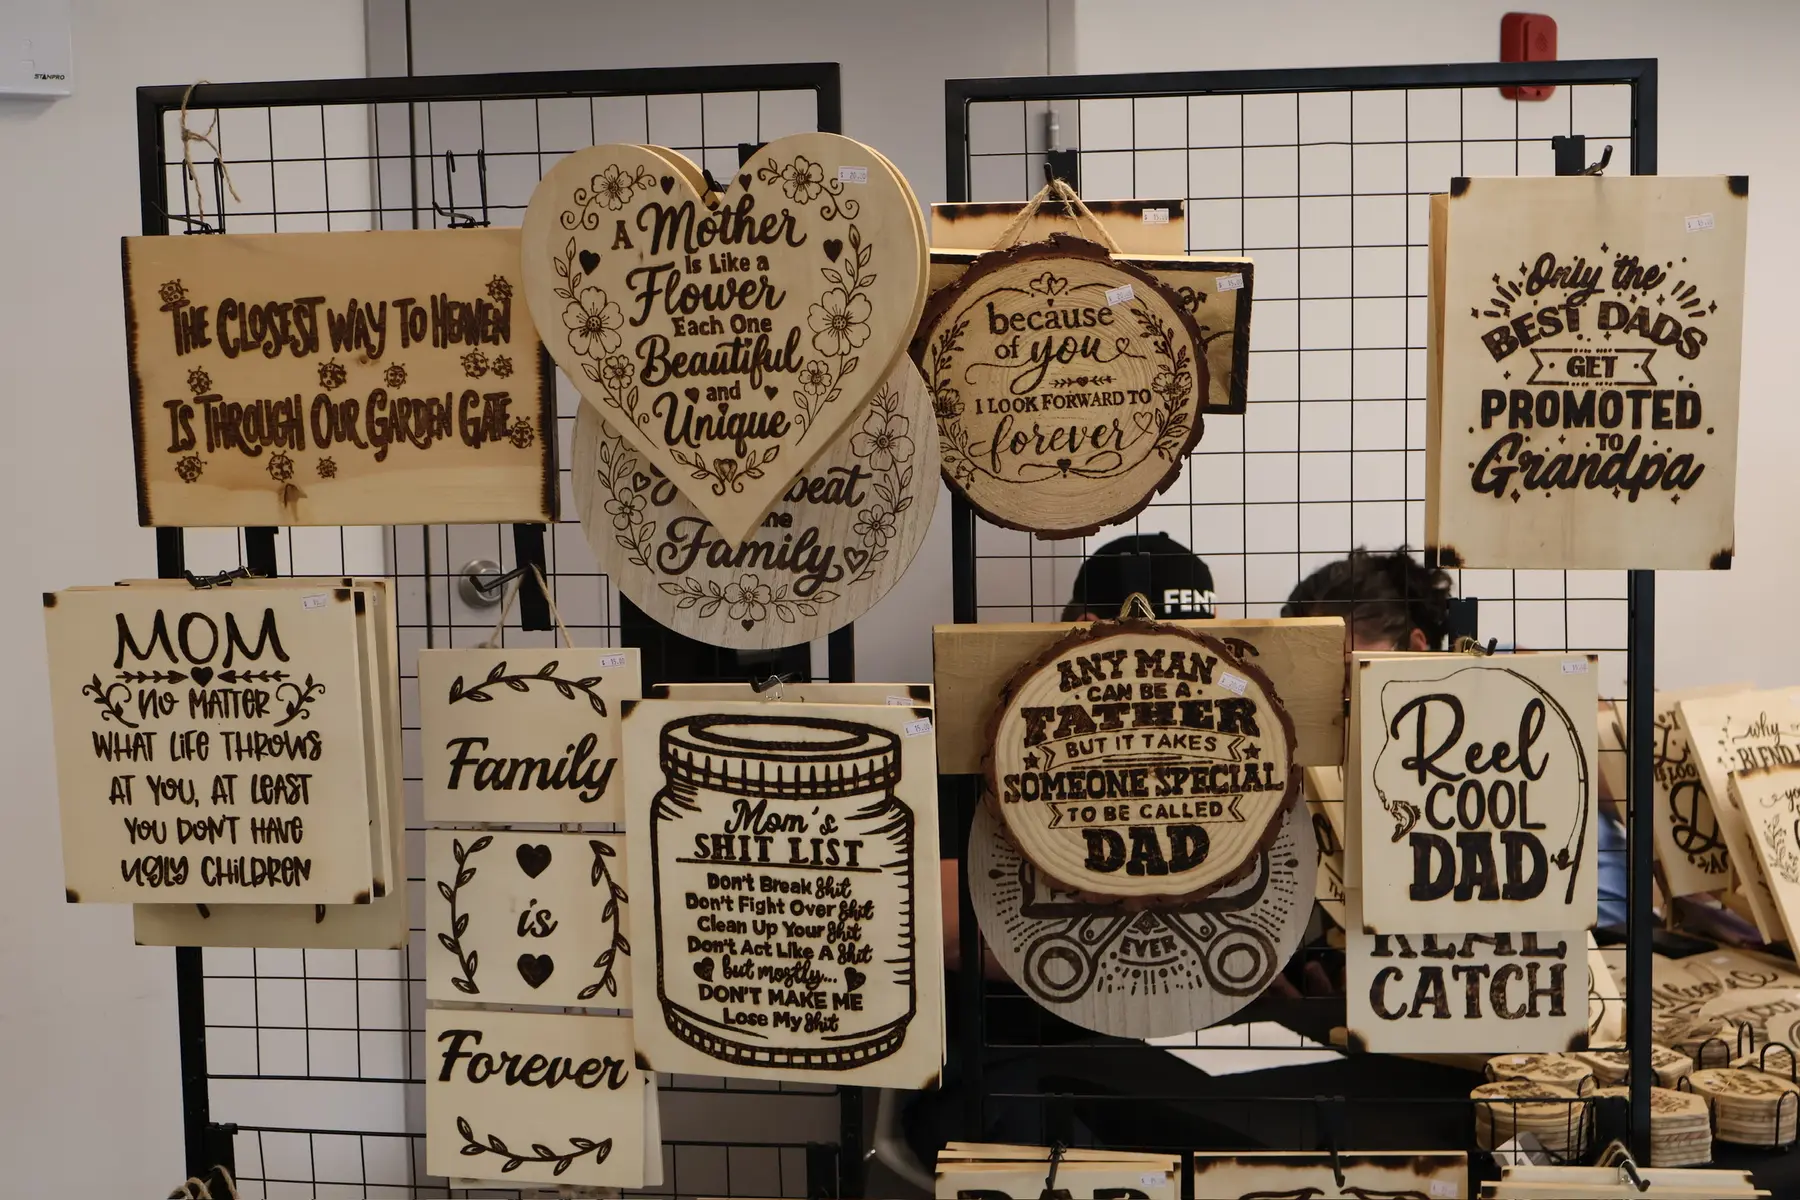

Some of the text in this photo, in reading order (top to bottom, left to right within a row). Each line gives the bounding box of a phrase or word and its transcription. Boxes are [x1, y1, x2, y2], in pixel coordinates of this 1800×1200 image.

[34, 73, 65, 81] STANPRO
[611, 193, 807, 256] A Mother
[685, 252, 770, 275] Is Like a
[1526, 252, 1666, 306] Only the
[625, 261, 786, 328] Flower
[160, 299, 213, 356] THE
[215, 296, 326, 358] CLOSEST
[327, 298, 387, 359] WAY
[392, 297, 427, 349] TO
[672, 314, 772, 337] Each One
[985, 302, 1115, 335] because
[1482, 301, 1708, 362] BEST DADS
[635, 326, 803, 389] Beautiful
[994, 334, 1102, 396] of you
[1566, 355, 1618, 379] GET
[706, 380, 741, 402] and
[975, 388, 1151, 415] I LOOK FORWARD TO
[1481, 390, 1702, 430] PROMOTED
[163, 387, 513, 462] IS THROUGH OUR GARDEN GATE
[652, 392, 791, 459] Unique
[987, 413, 1126, 473] forever
[1596, 433, 1623, 451] TO
[1471, 432, 1705, 503] Grandpa
[656, 516, 845, 597] Family
[114, 608, 290, 668] MOM
[1056, 649, 1128, 693] ANY
[1135, 648, 1218, 685] MAN
[1087, 681, 1192, 701] CAN BE A
[1020, 697, 1261, 748] FATHER
[1390, 692, 1550, 787] Reel
[92, 731, 157, 762] WHAT
[1065, 733, 1218, 759] BUT IT TAKES
[446, 732, 618, 803] Family
[1003, 762, 1285, 803] SOMEONE SPECIAL
[109, 775, 135, 805] AT
[211, 775, 238, 805] AT
[1425, 779, 1546, 831] COOL
[124, 817, 166, 845] YOU
[724, 799, 838, 835] Mom's
[1067, 800, 1224, 823] TO BE CALLED
[694, 834, 864, 867] SHIT LIST
[1081, 825, 1211, 876] DAD
[1409, 830, 1549, 902] DAD
[707, 873, 755, 891] Don't
[760, 876, 812, 895] Break
[517, 898, 558, 938] is
[686, 892, 734, 912] Don't
[739, 895, 785, 918] Fight
[790, 899, 836, 918] Over
[697, 916, 747, 935] Clean
[752, 919, 778, 939] Up
[782, 922, 825, 939] Your
[1118, 935, 1178, 959] EVER
[687, 935, 736, 956] Don't
[740, 938, 772, 958] Act
[777, 941, 815, 962] Like
[818, 944, 834, 961] A
[722, 954, 755, 980] but
[698, 983, 864, 1011] DON'T MAKE ME
[1369, 961, 1568, 1021] CATCH
[723, 1007, 768, 1027] Lose
[772, 1010, 803, 1030] My
[438, 1028, 629, 1091] Forever
